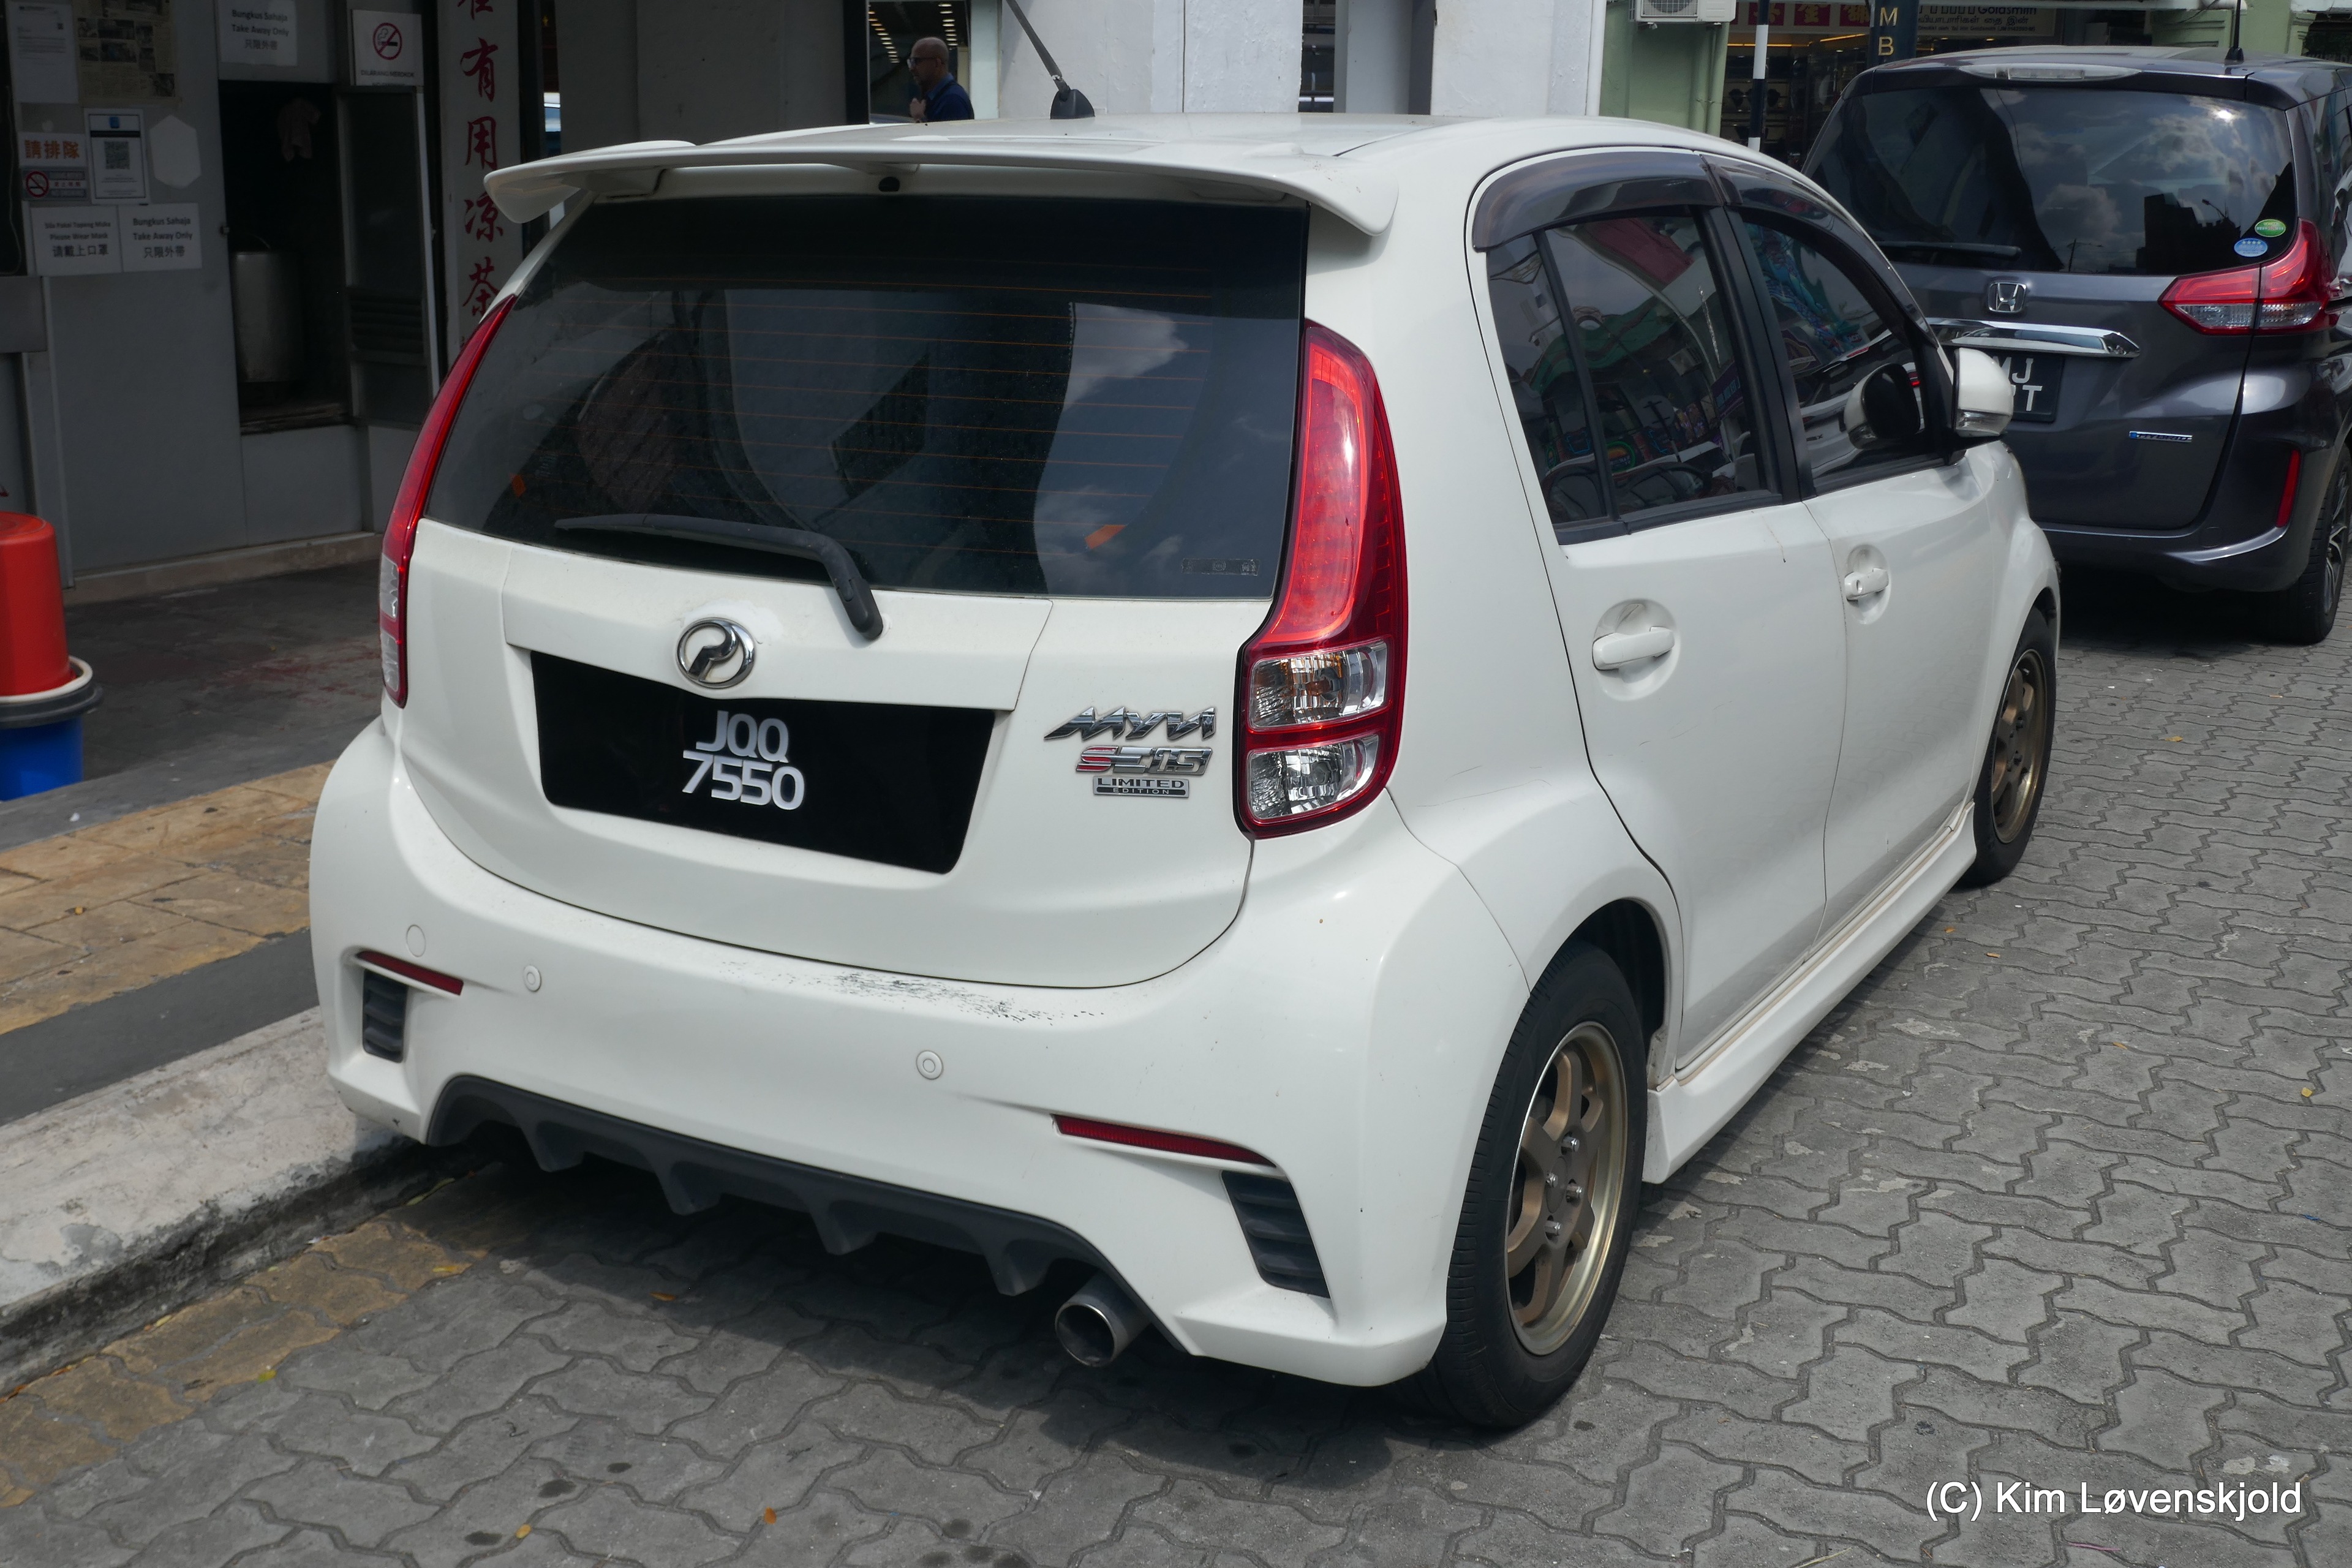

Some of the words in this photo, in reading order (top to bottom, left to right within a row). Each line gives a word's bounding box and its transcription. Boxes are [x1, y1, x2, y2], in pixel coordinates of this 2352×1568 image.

[232, 9, 263, 20] Bungkus
[263, 12, 288, 23] Sahaja
[232, 24, 249, 33] Take
[251, 26, 270, 37] Away
[273, 28, 290, 37] Only
[24, 139, 80, 159] 請排隊
[133, 217, 164, 228] Bungkus
[166, 216, 191, 226] Sahaja
[133, 232, 151, 241] Take
[153, 232, 173, 241] Away
[175, 231, 193, 241] Only
[2011, 384, 2043, 412] T
[695, 710, 790, 763] JQQ
[682, 750, 805, 810] 7550
[1097, 778, 1185, 789] LIMITED
